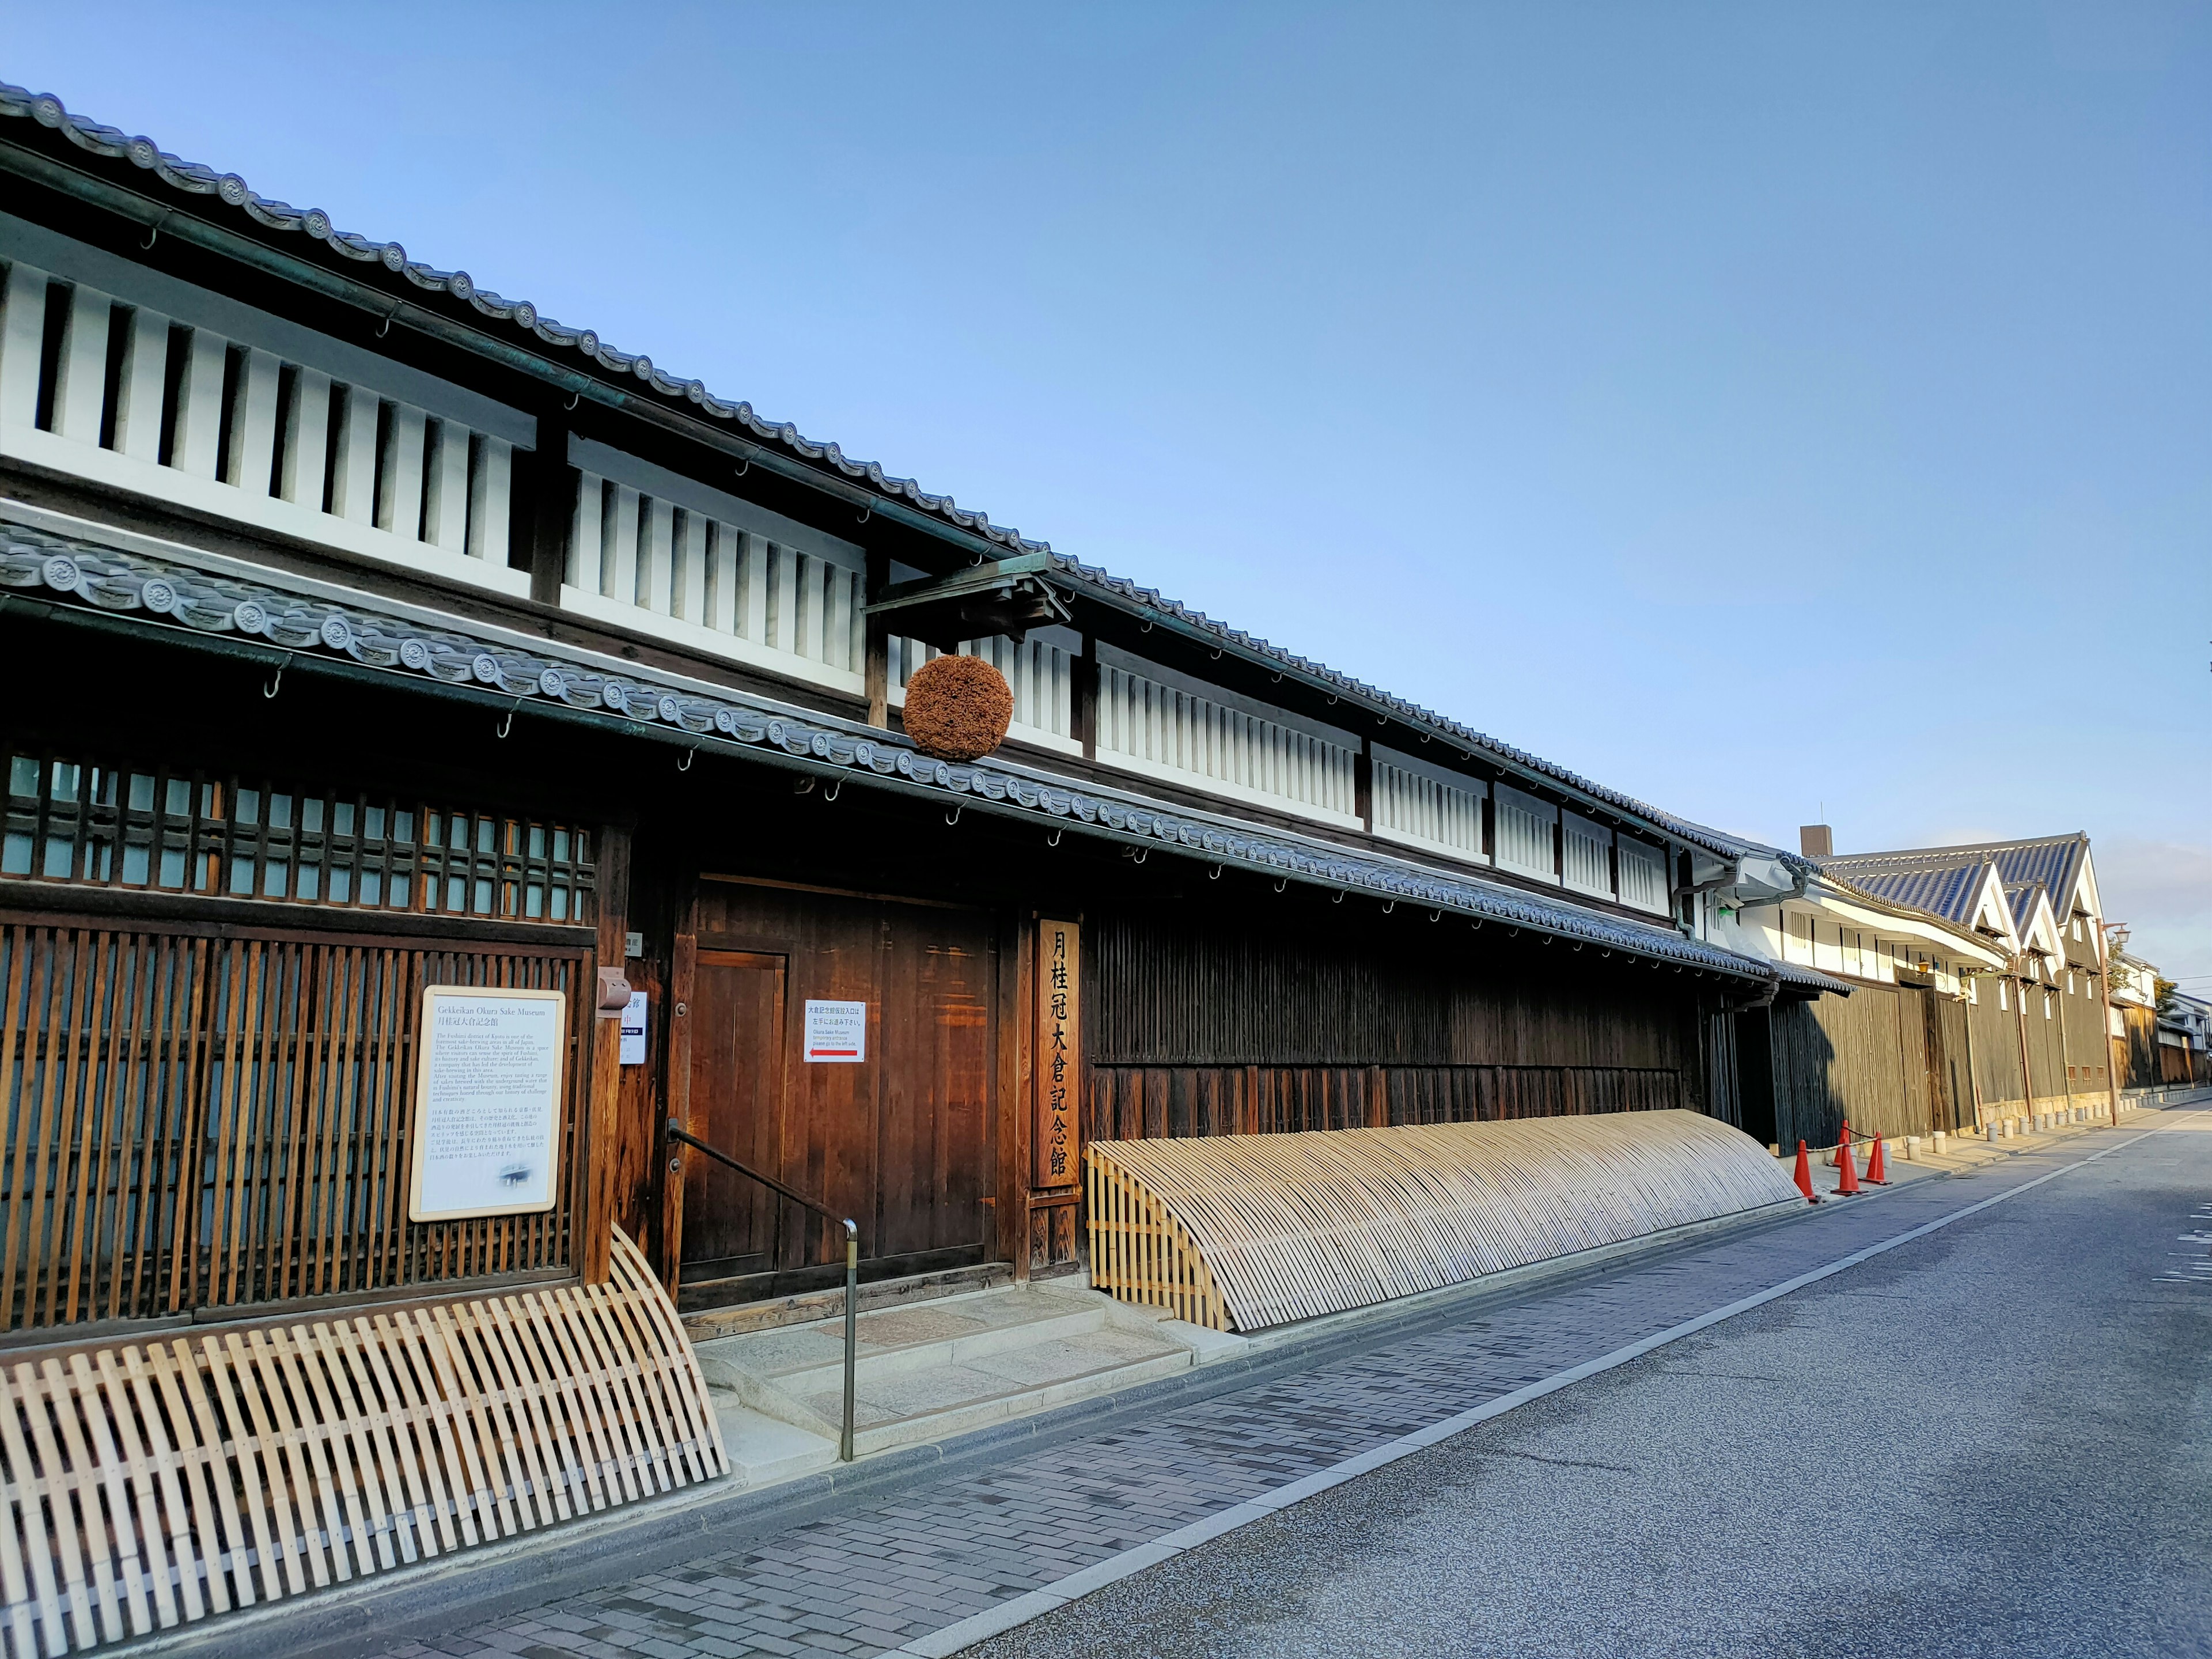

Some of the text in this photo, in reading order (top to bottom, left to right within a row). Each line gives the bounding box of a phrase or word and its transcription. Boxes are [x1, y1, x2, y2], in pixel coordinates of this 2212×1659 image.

[438, 1006, 474, 1014] Gekkeikan
[438, 1017, 498, 1027] 月桂冠大倉記念館
[813, 1018, 861, 1026] 左手にお進み下さい。
[1050, 931, 1068, 1176] 月桂冠大倉記念館
